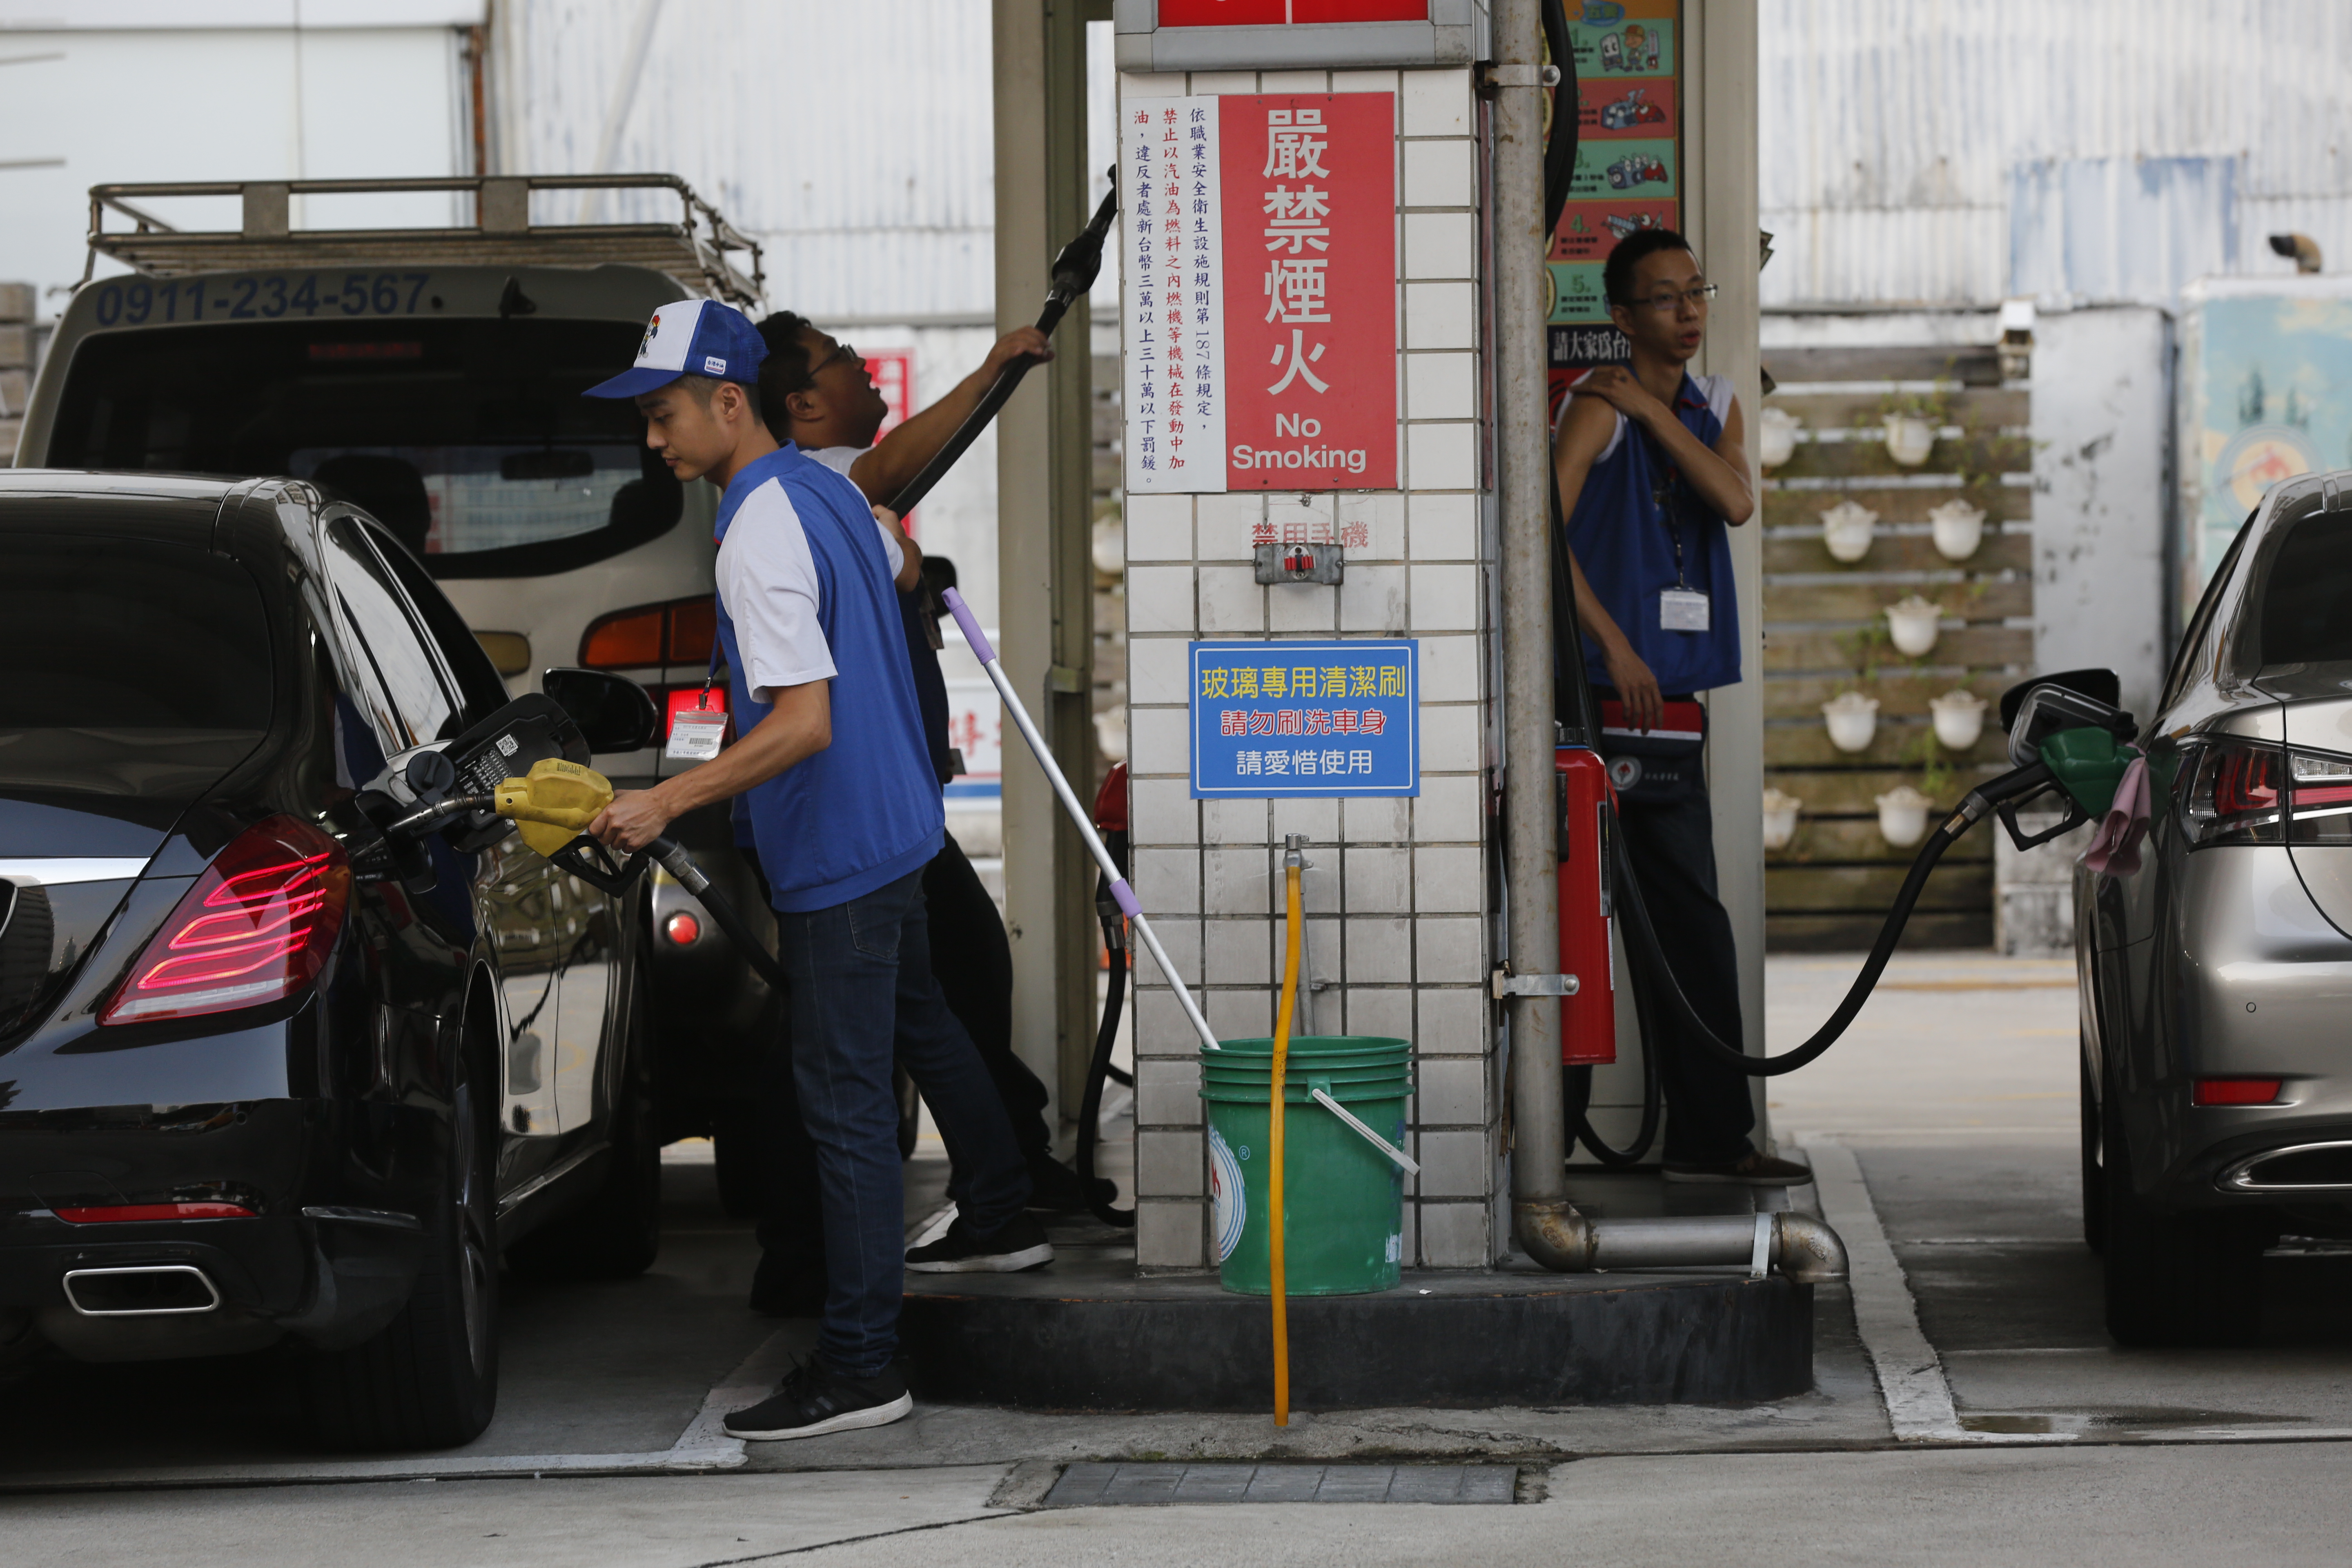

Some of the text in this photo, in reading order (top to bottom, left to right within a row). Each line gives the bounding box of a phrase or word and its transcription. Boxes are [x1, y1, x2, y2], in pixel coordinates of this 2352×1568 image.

[1571, 214, 1590, 233] 4.
[1262, 109, 1331, 396] 嚴禁煙火
[1571, 274, 1590, 293] 5.
[96, 273, 431, 326] 0911-234-567
[1276, 413, 1321, 438] No
[1232, 444, 1366, 474] Smoking
[1201, 665, 1405, 699] 玻璃專用清潔刷
[1221, 708, 1387, 736] 請勿刷洗車身
[1236, 749, 1372, 775] 請愛惜使用
